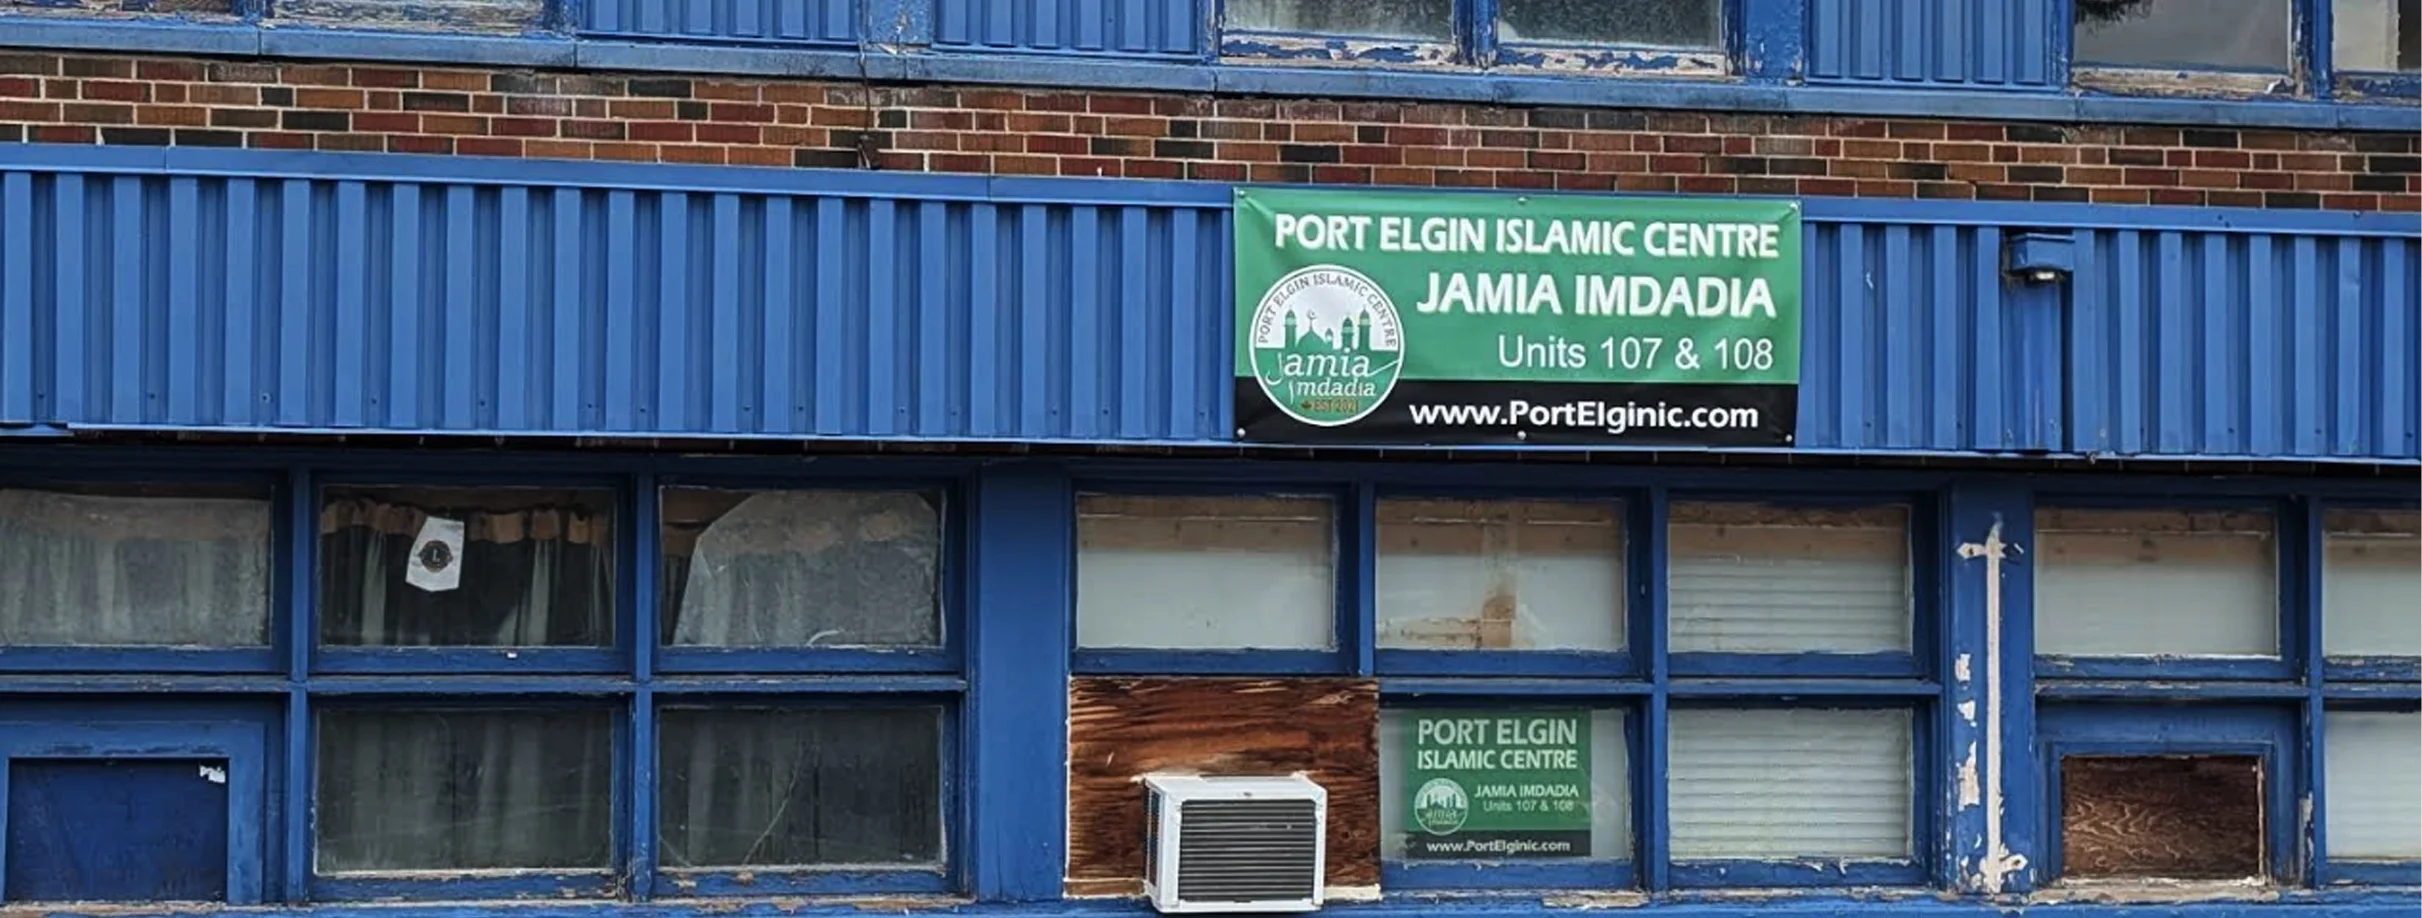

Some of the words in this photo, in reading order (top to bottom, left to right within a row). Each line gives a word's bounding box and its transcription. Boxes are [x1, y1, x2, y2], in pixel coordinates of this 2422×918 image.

[1275, 213, 1371, 251] PORT
[1379, 217, 1486, 253] ELGIN
[1496, 218, 1636, 256] ISLAMIC
[1643, 221, 1779, 258] CENTRE
[1258, 307, 1277, 345] PORT
[1273, 276, 1311, 309] ELGIN
[1313, 273, 1369, 298] ISLAMIC
[1367, 294, 1397, 348] CENTRE
[1416, 272, 1563, 315] JAMIA
[1574, 274, 1777, 318] IMDADIA
[1266, 347, 1374, 386] Jamia
[1499, 335, 1587, 368] Units
[1601, 337, 1662, 370] 107
[1675, 338, 1700, 370] &
[1714, 338, 1774, 371] 108
[1409, 400, 1759, 434] www.PortElginic.com
[1418, 719, 1490, 745] PORT
[1497, 719, 1577, 745] ELGIN
[1417, 749, 1496, 769] ISLAMIC
[1501, 749, 1578, 769] CENTRE
[1474, 784, 1517, 798] JAMIA
[1519, 784, 1579, 798] IMDADIA
[1483, 800, 1512, 812] Units
[1516, 800, 1537, 812] 107
[1539, 800, 1549, 812] &
[1426, 840, 1571, 854] www.PortElginic.com
